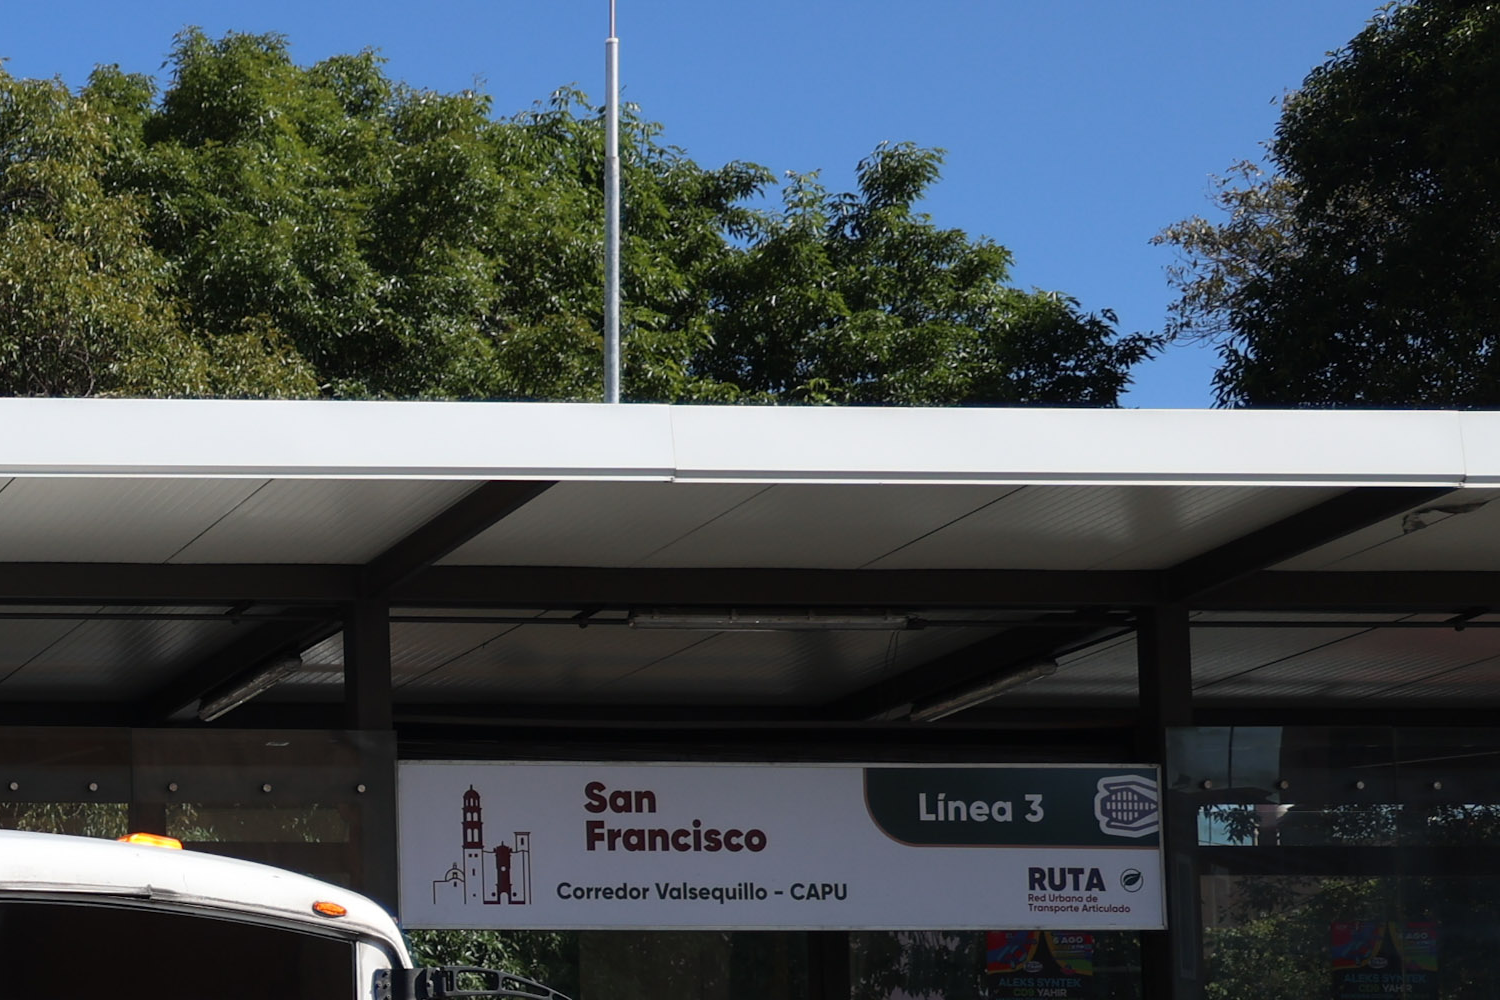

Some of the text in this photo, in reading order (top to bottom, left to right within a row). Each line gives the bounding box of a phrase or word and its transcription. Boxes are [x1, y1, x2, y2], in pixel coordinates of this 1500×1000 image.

[583, 781, 657, 814] San
[918, 791, 1045, 823] Línea 3
[585, 819, 767, 852] Francisco
[1028, 867, 1106, 892] RUTA
[556, 882, 650, 901] Corredor
[654, 882, 768, 904] Valsequillo
[790, 882, 847, 901] CAPU
[1028, 894, 1098, 903] Red Urbana de
[1028, 904, 1131, 914] Transporte Articulado
